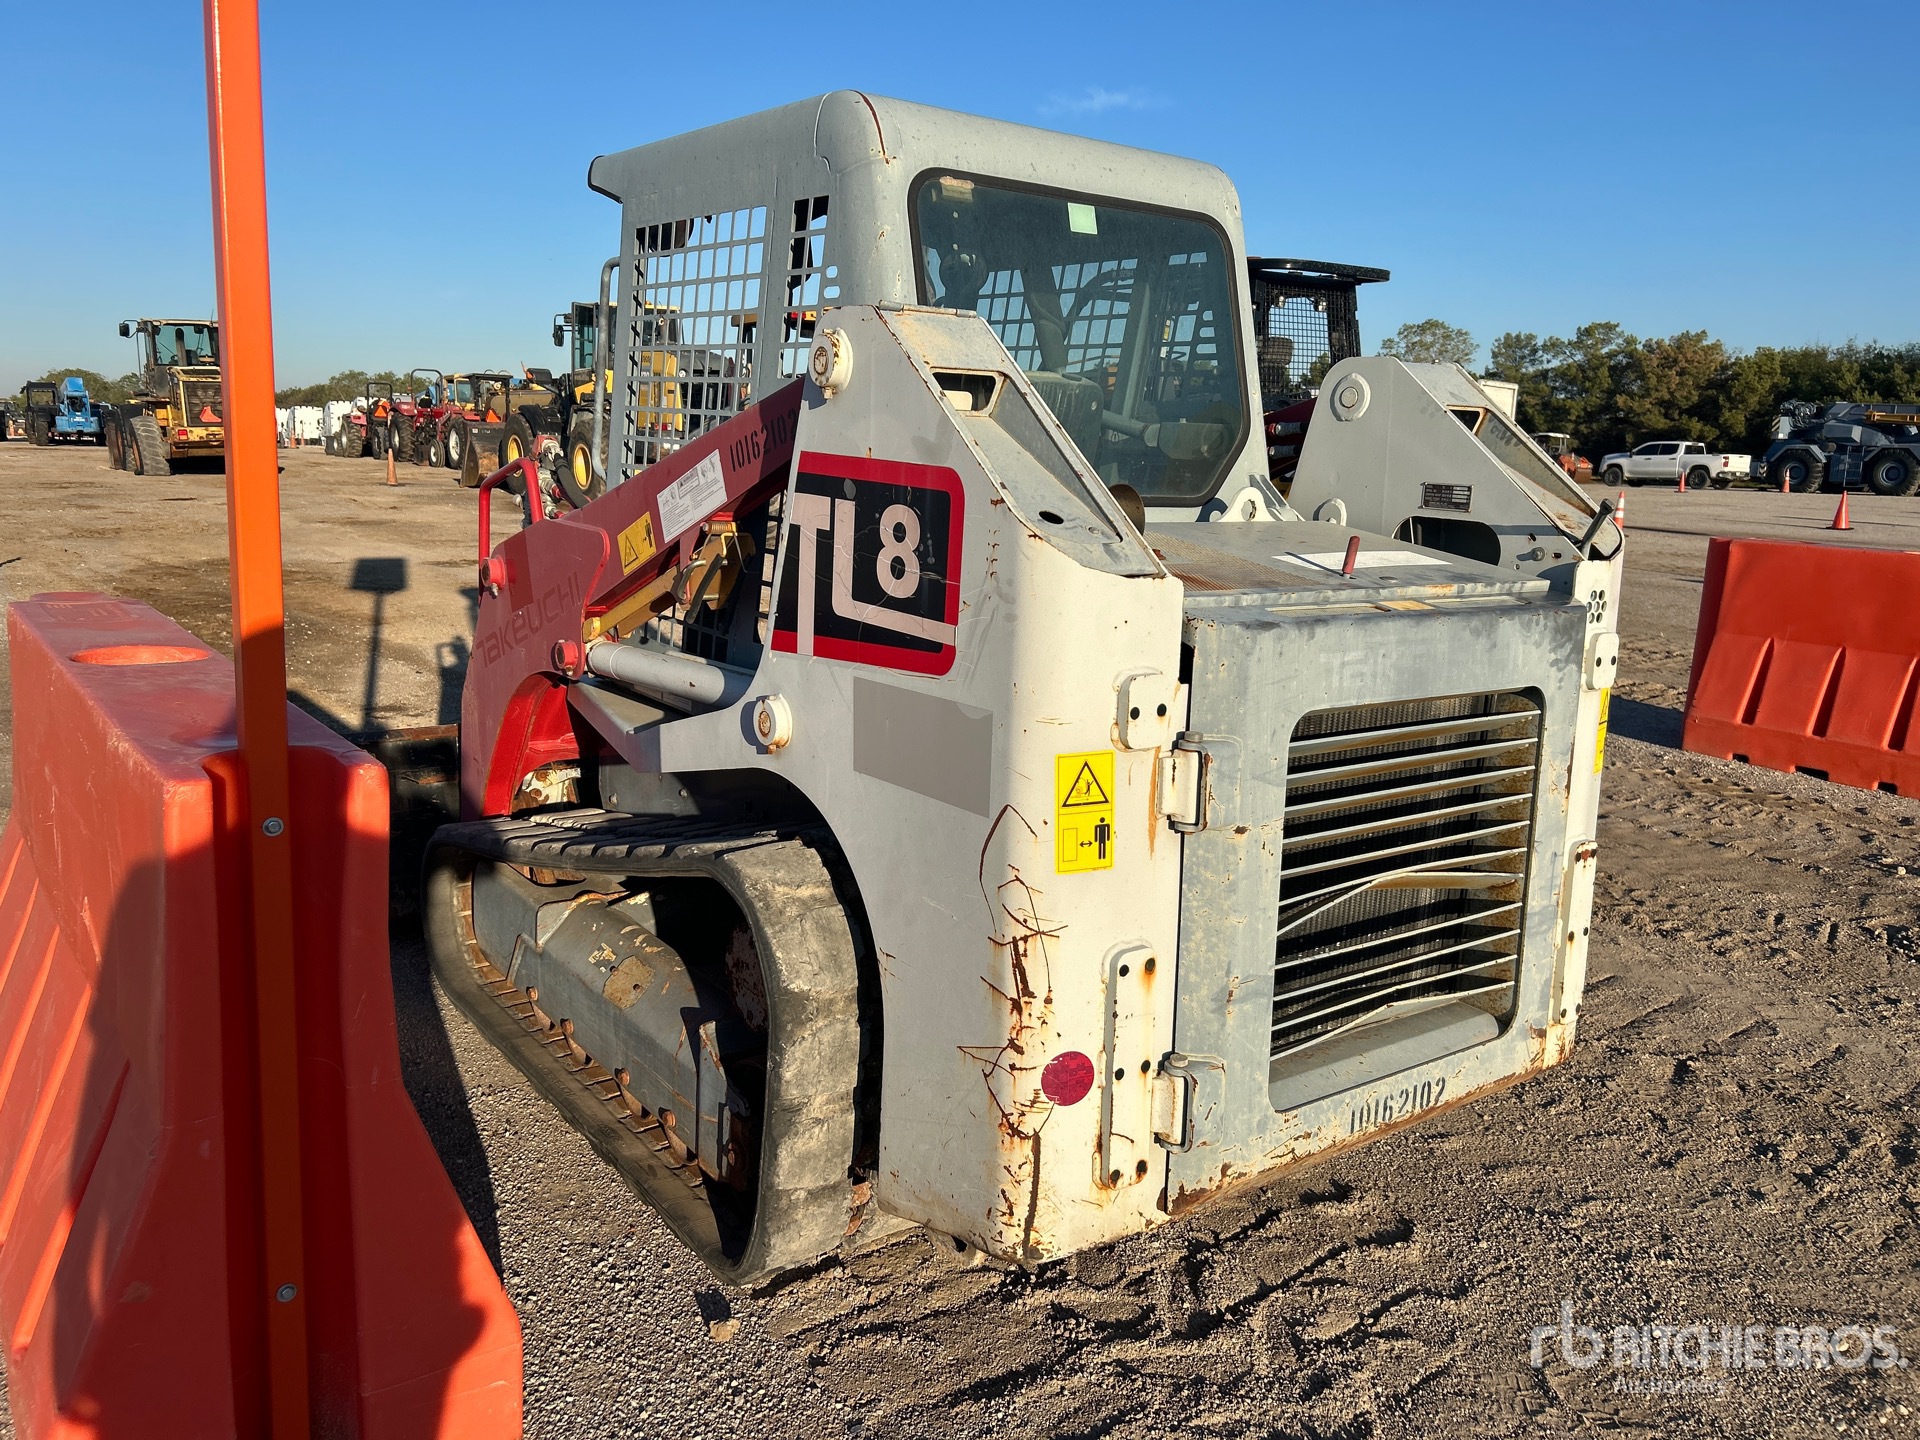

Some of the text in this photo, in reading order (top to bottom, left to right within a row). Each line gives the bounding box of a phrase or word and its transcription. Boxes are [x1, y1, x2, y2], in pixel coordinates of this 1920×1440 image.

[729, 408, 798, 473] 10162102
[789, 492, 956, 656] TL8
[1350, 1076, 1446, 1133] 10162102
